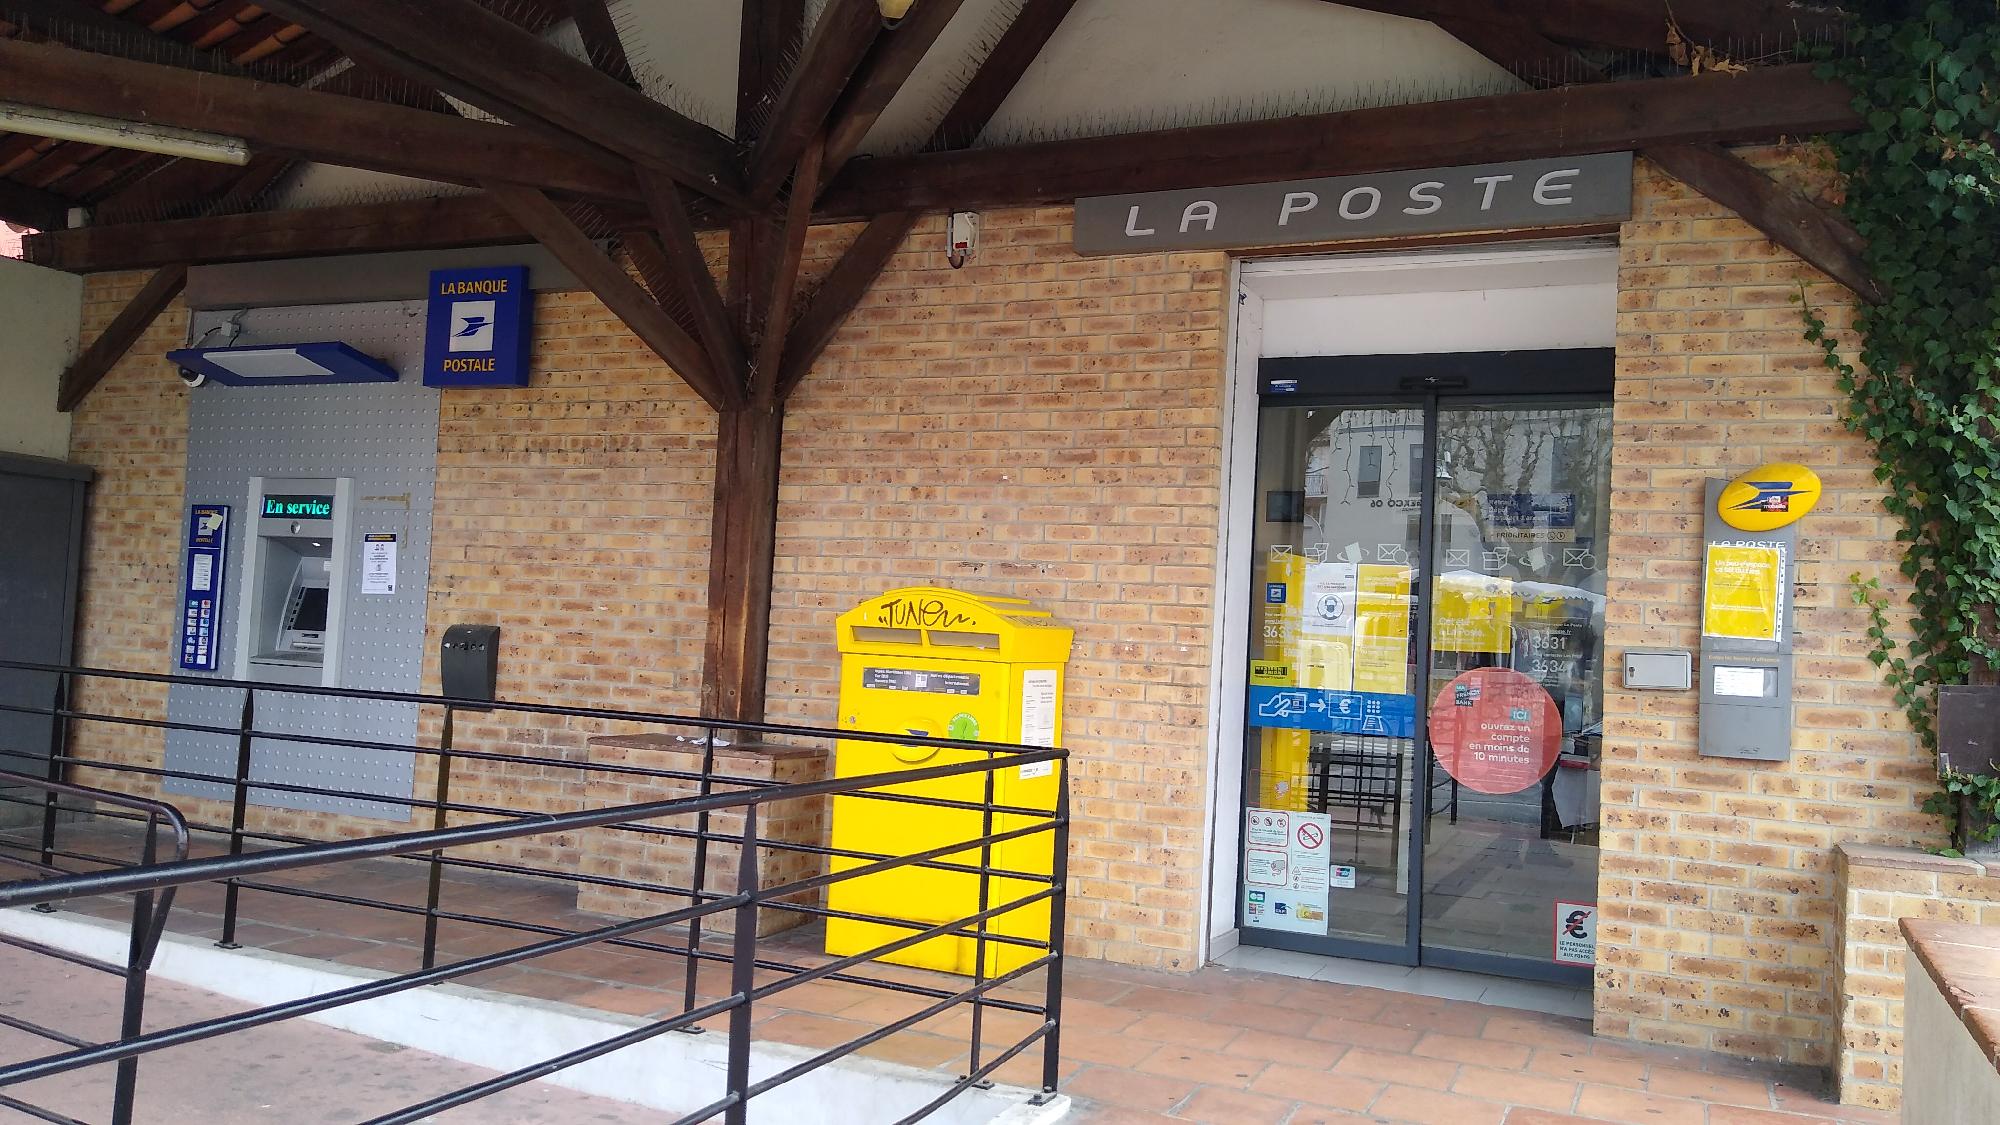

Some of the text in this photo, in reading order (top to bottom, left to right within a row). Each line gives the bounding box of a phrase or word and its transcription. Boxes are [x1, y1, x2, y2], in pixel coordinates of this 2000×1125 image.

[1124, 168, 1580, 237] LA POSTE
[441, 279, 508, 295] LA BANQUE
[443, 358, 496, 372] POSTALE
[266, 499, 330, 515] En service
[1532, 636, 1565, 650] 3631
[1531, 659, 1568, 673] 3634
[1513, 710, 1527, 720] ICI
[1480, 723, 1516, 732] ouvrez
[1491, 733, 1530, 744] compte
[1483, 742, 1515, 752] moins
[1517, 745, 1530, 753] de
[1474, 752, 1530, 764] 10 minutes
